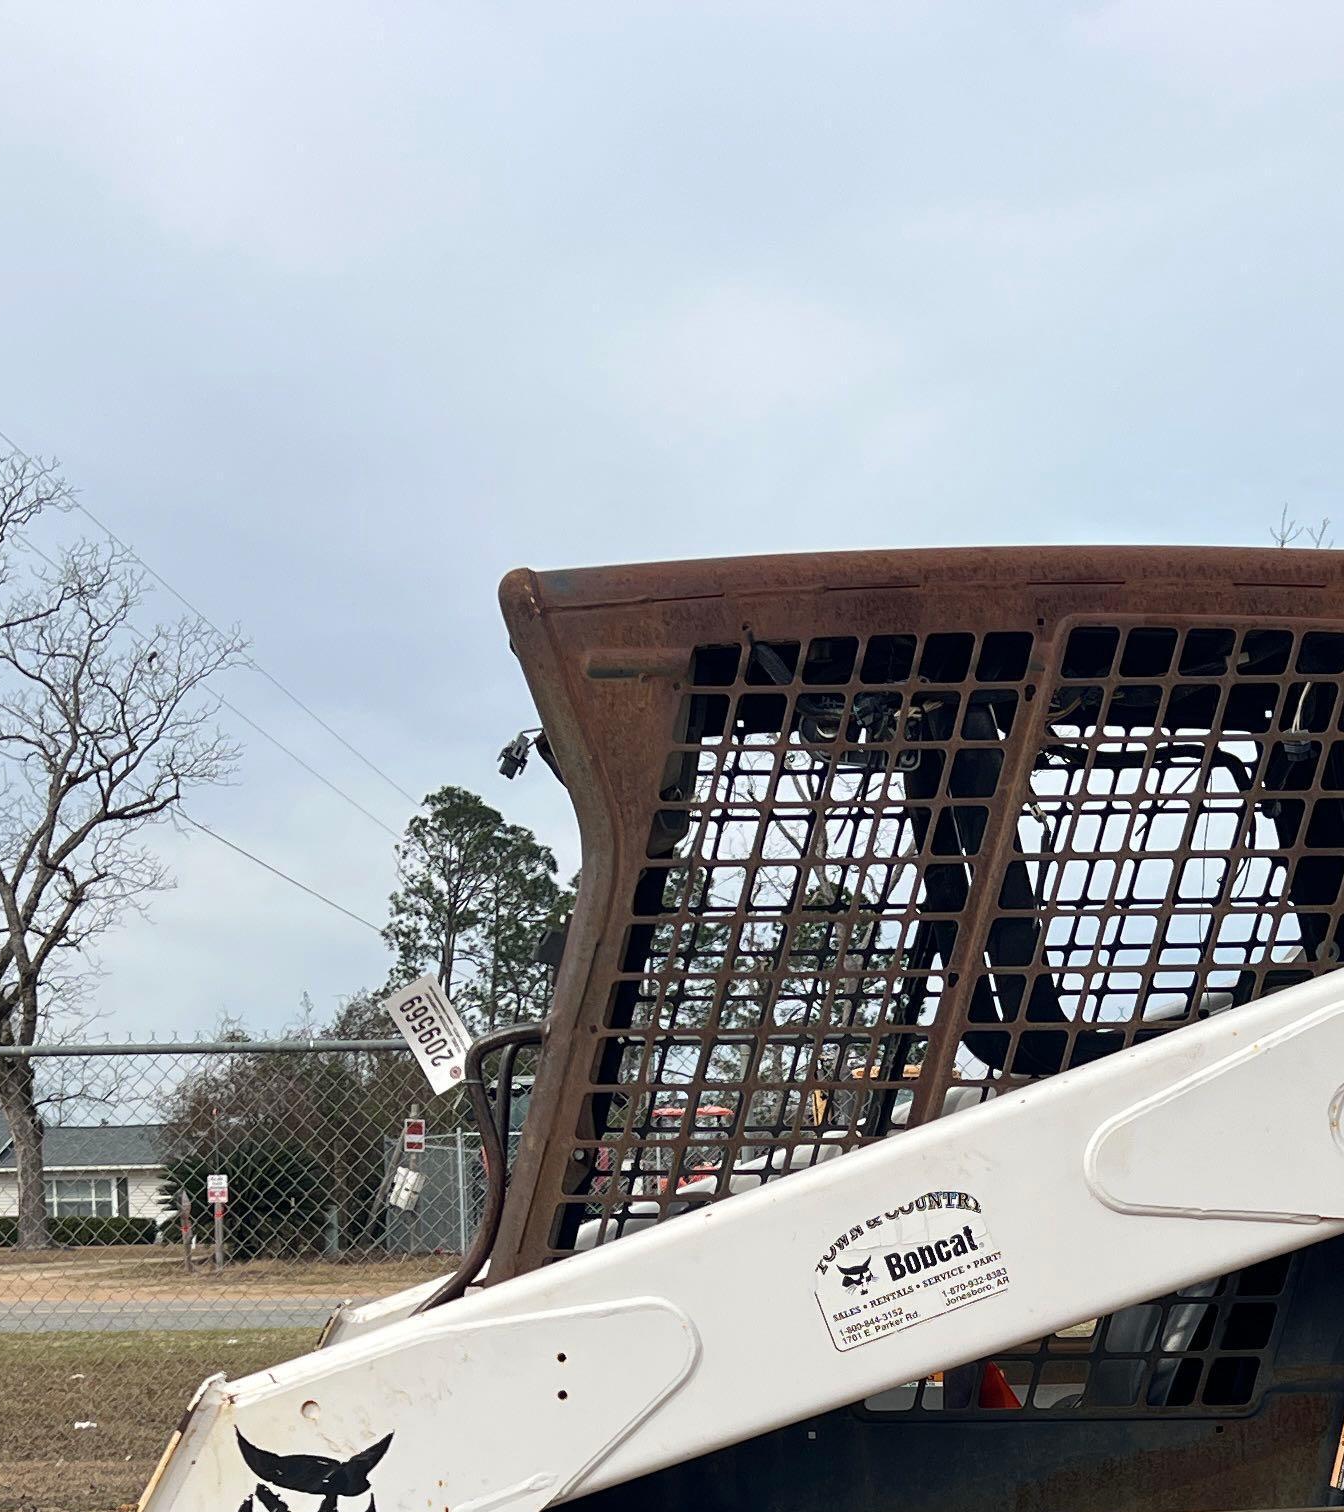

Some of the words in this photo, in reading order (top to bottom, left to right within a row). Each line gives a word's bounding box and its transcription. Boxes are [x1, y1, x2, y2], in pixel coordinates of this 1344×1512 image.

[399, 995, 454, 1068] 209569
[884, 1225, 979, 1282] Bobcat
[832, 1305, 862, 1322] SALES
[869, 1285, 915, 1309] RENTALS
[921, 1265, 966, 1288] SERVICE
[842, 1332, 863, 1345] 1701
[874, 1317, 904, 1333] Parker
